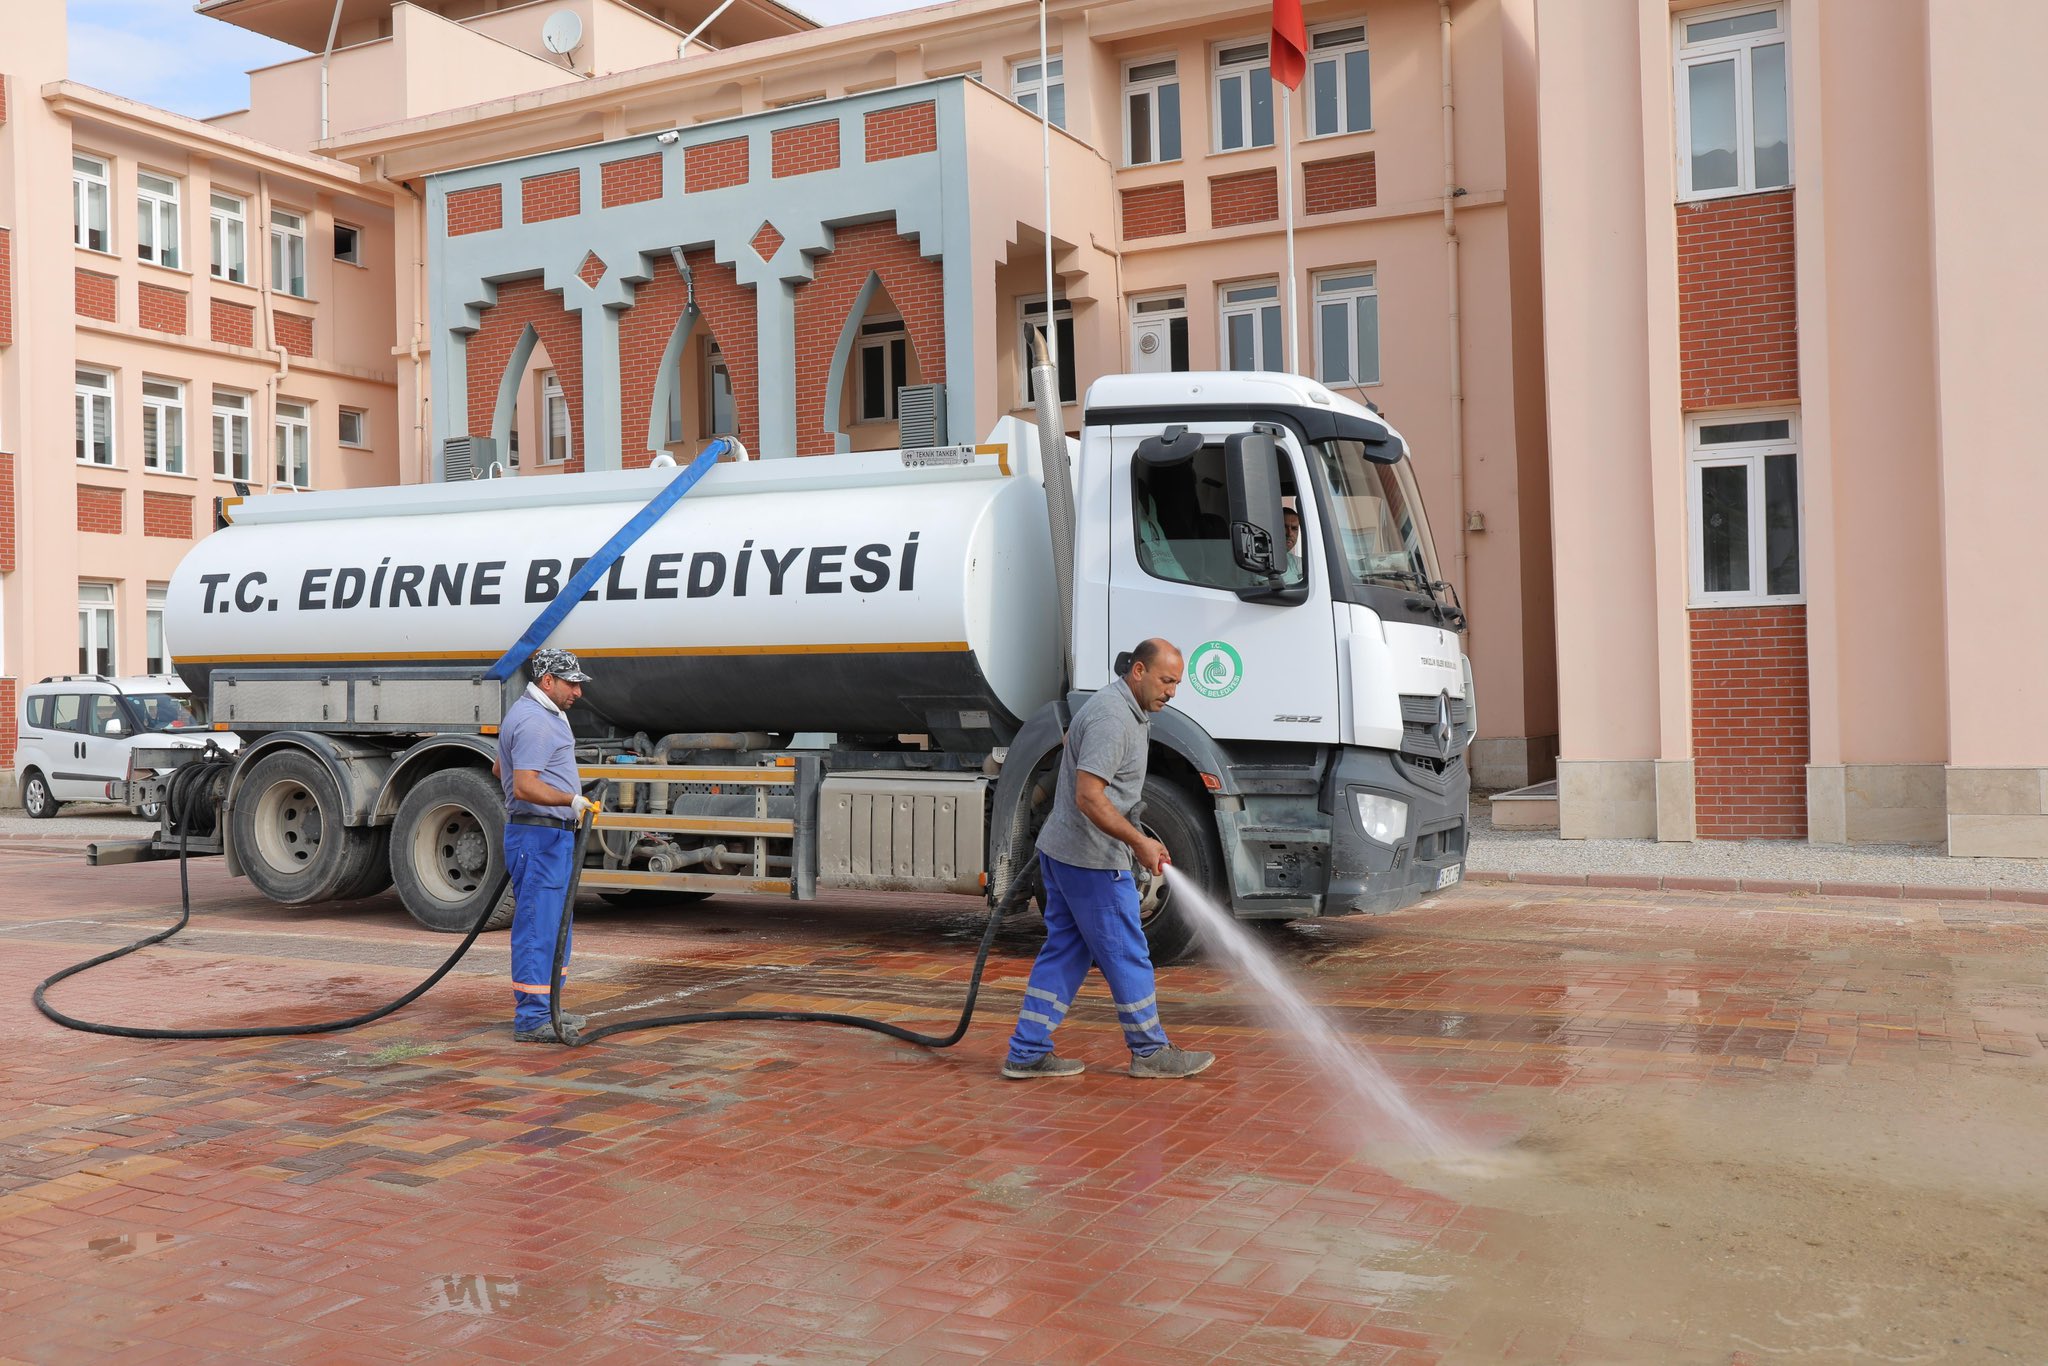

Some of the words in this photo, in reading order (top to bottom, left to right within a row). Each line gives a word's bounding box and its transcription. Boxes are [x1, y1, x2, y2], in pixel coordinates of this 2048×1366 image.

[916, 450, 934, 458] TEKNİK
[936, 449, 957, 457] TANKER
[200, 571, 278, 614] T.C.
[298, 557, 506, 611] EDİRNE
